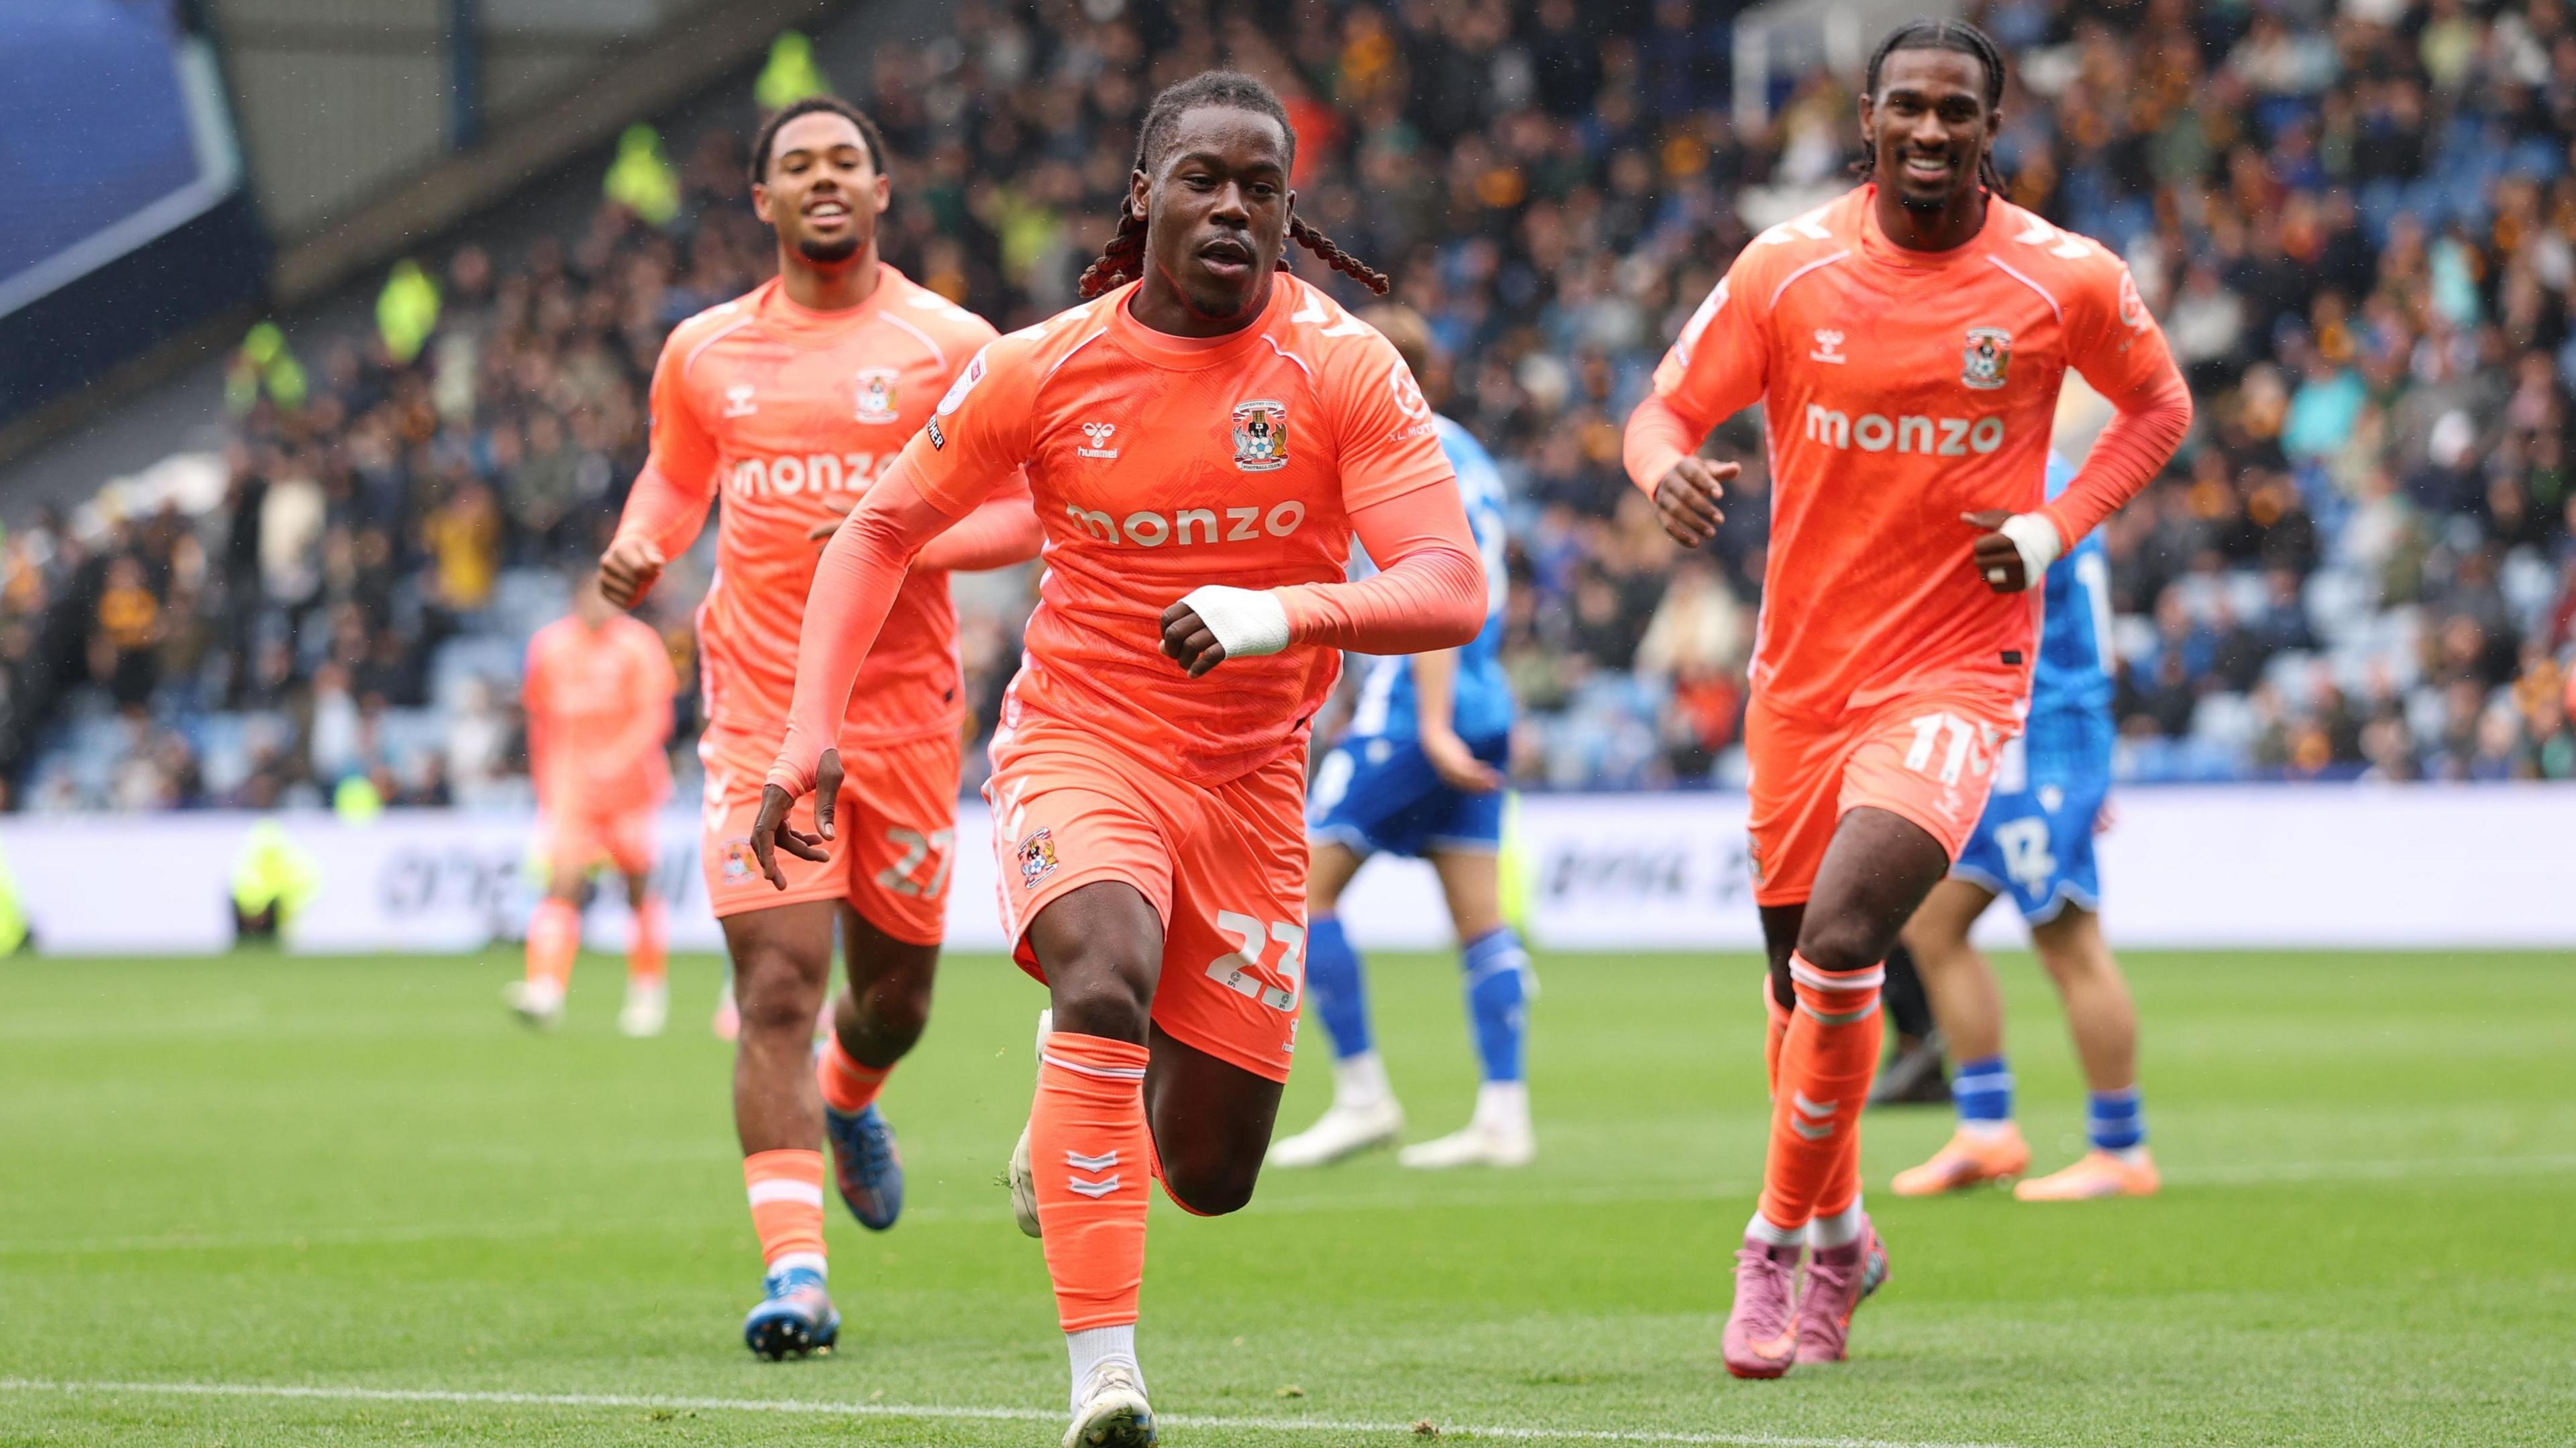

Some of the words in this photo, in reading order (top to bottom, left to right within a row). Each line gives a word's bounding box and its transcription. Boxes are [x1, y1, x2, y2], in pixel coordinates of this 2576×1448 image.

[1077, 445, 1118, 459] hummel
[1806, 402, 2004, 455] monzo
[1066, 500, 1305, 547] monzo
[1904, 712, 1975, 789] 11
[873, 826, 954, 899] 27
[1205, 909, 1305, 1012] 23
